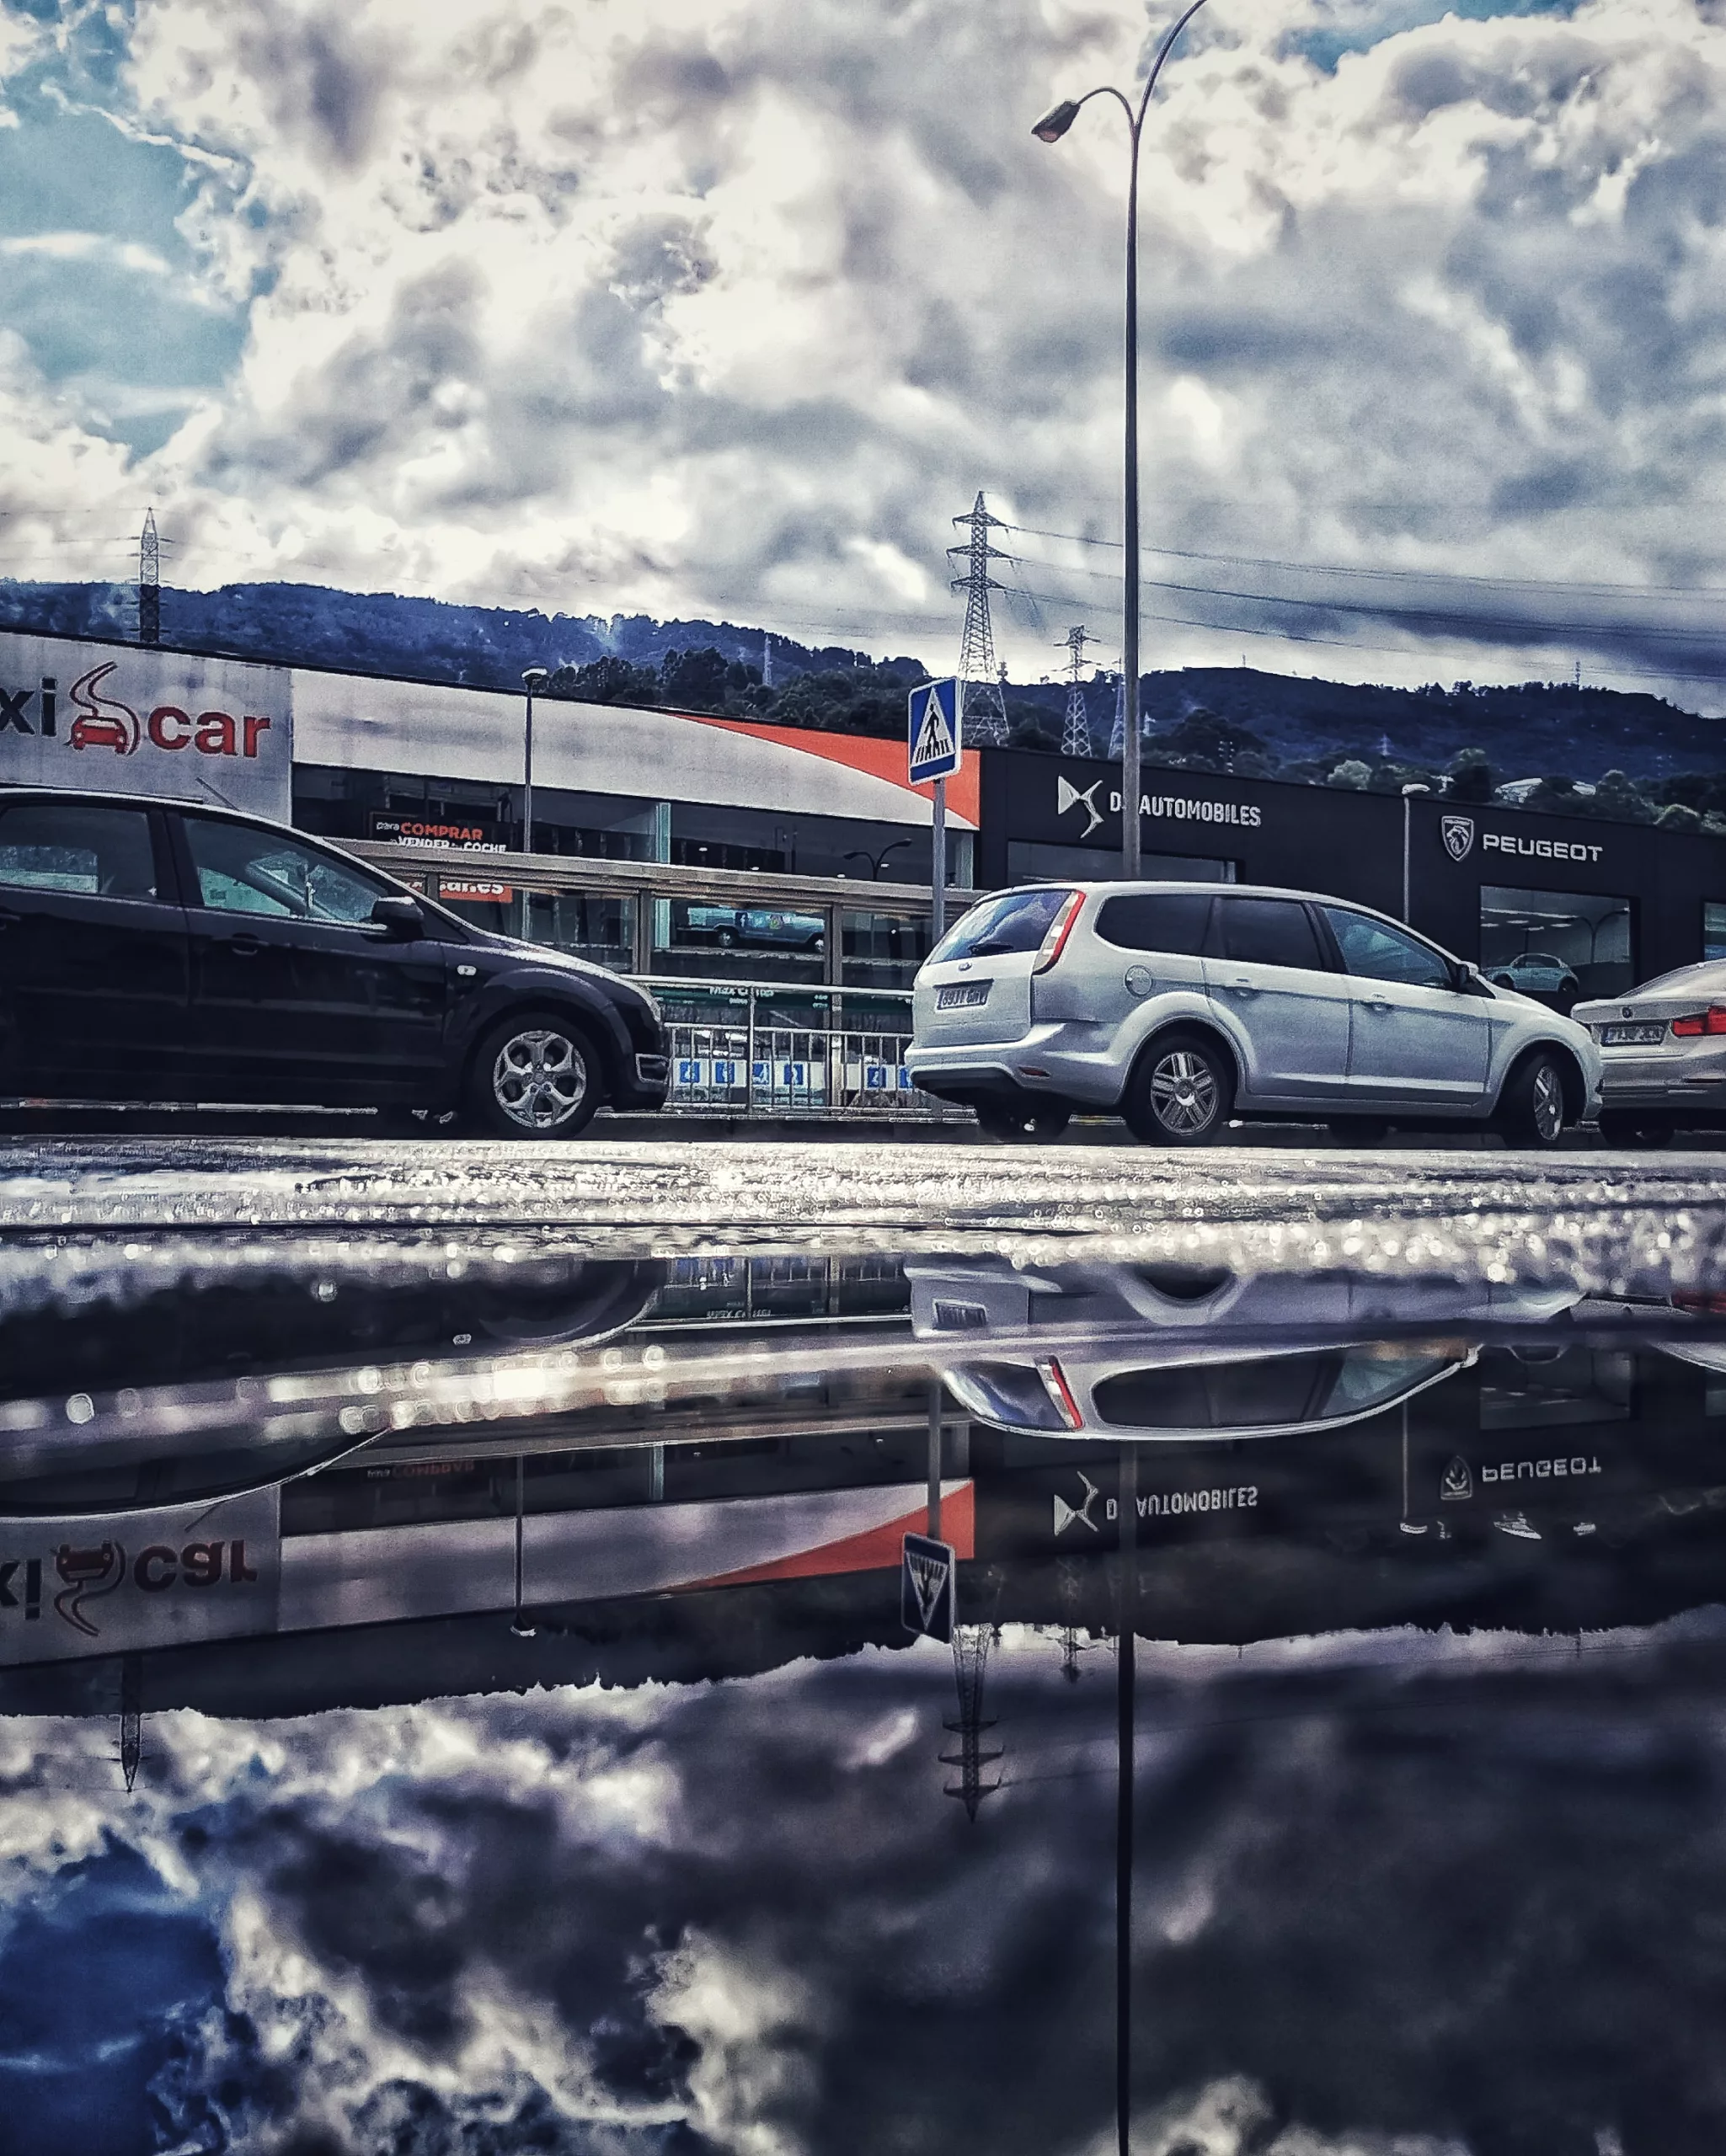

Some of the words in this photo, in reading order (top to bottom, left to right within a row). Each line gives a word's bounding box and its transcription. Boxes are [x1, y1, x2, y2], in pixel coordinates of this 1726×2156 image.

[147, 706, 271, 758] car
[1109, 791, 1125, 813] D
[1138, 794, 1262, 827] AUTOMOBILES
[398, 835, 450, 849] VENDER
[463, 841, 507, 853] COCHE
[400, 822, 484, 841] COMPRAR
[1483, 834, 1603, 862] PEUGEOT
